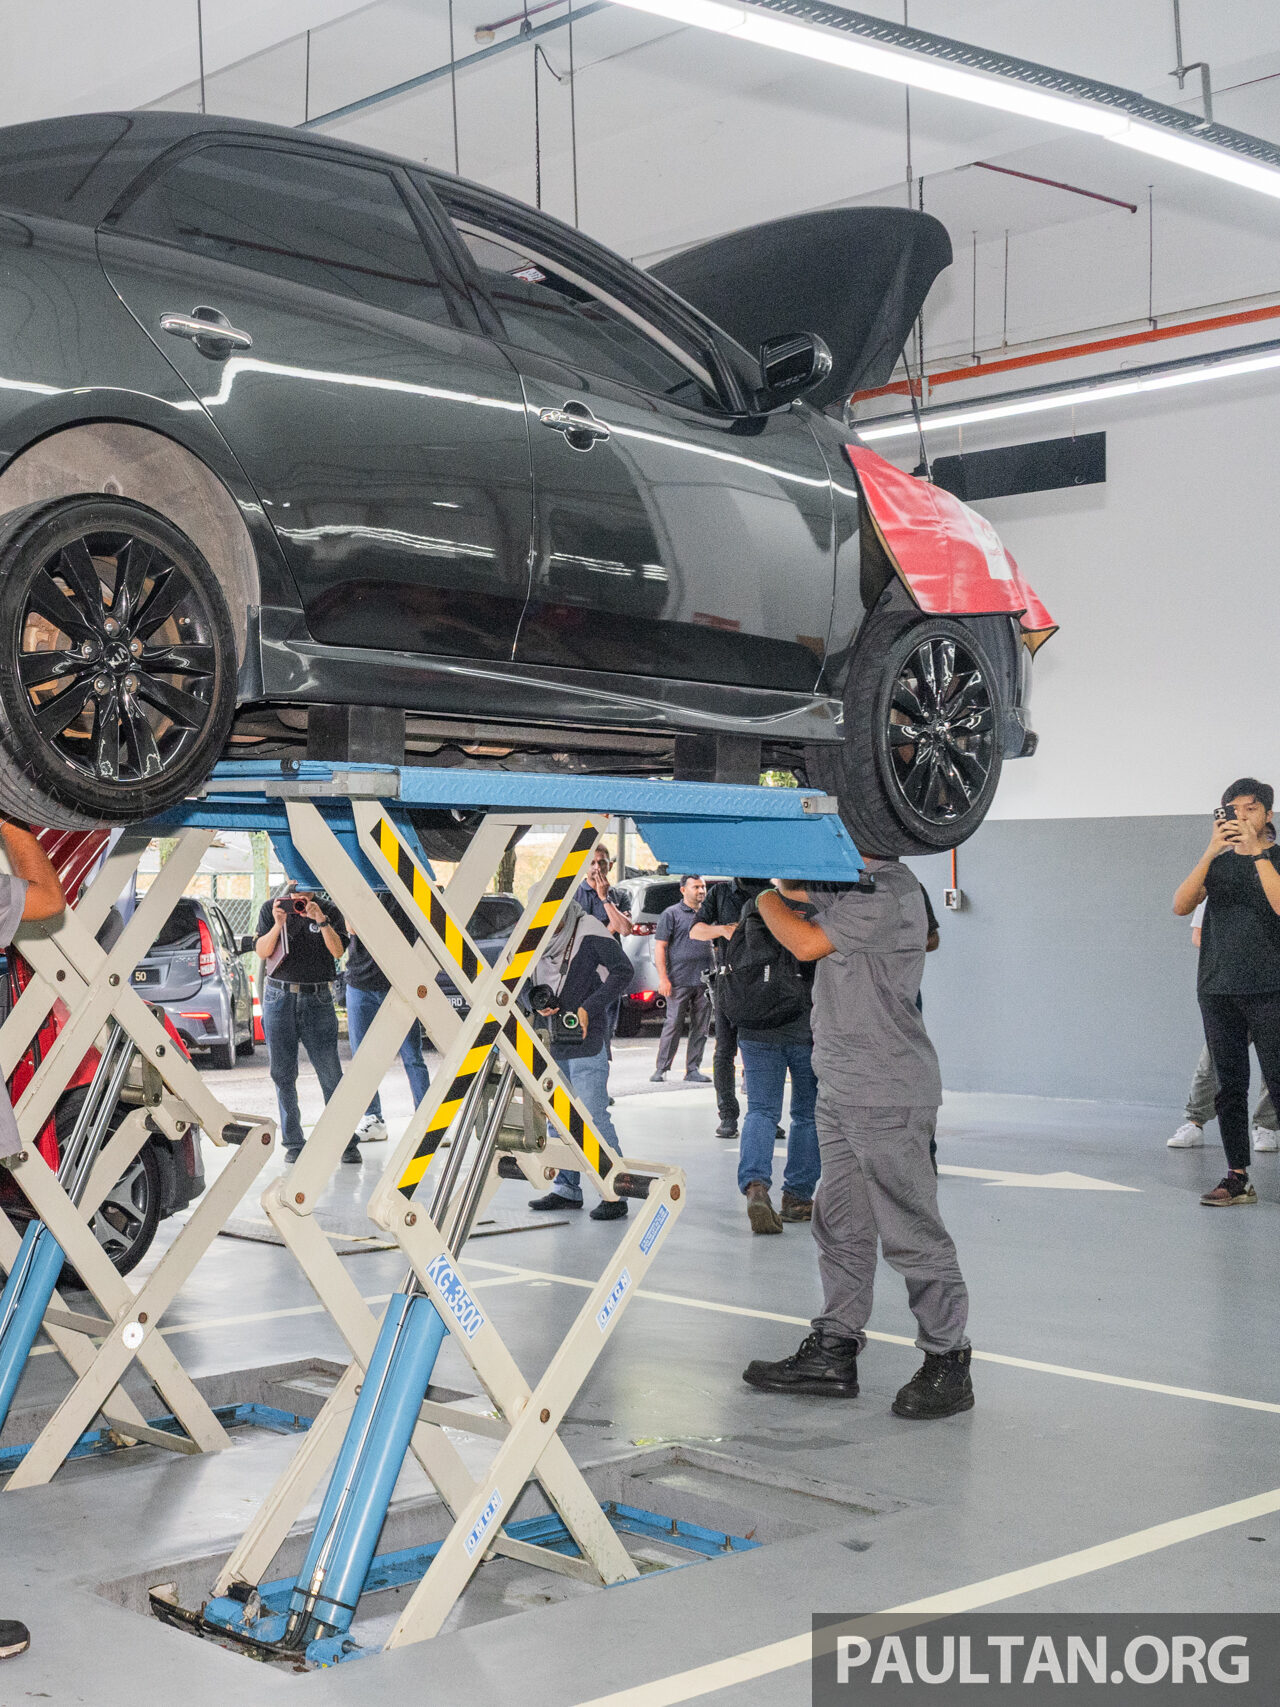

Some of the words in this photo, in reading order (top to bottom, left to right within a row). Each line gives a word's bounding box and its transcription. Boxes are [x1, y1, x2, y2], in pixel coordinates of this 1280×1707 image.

[135, 971, 147, 981] 50
[427, 1255, 483, 1336] KG.3500
[599, 1273, 629, 1324] OMCN
[467, 1493, 499, 1549] OMCN
